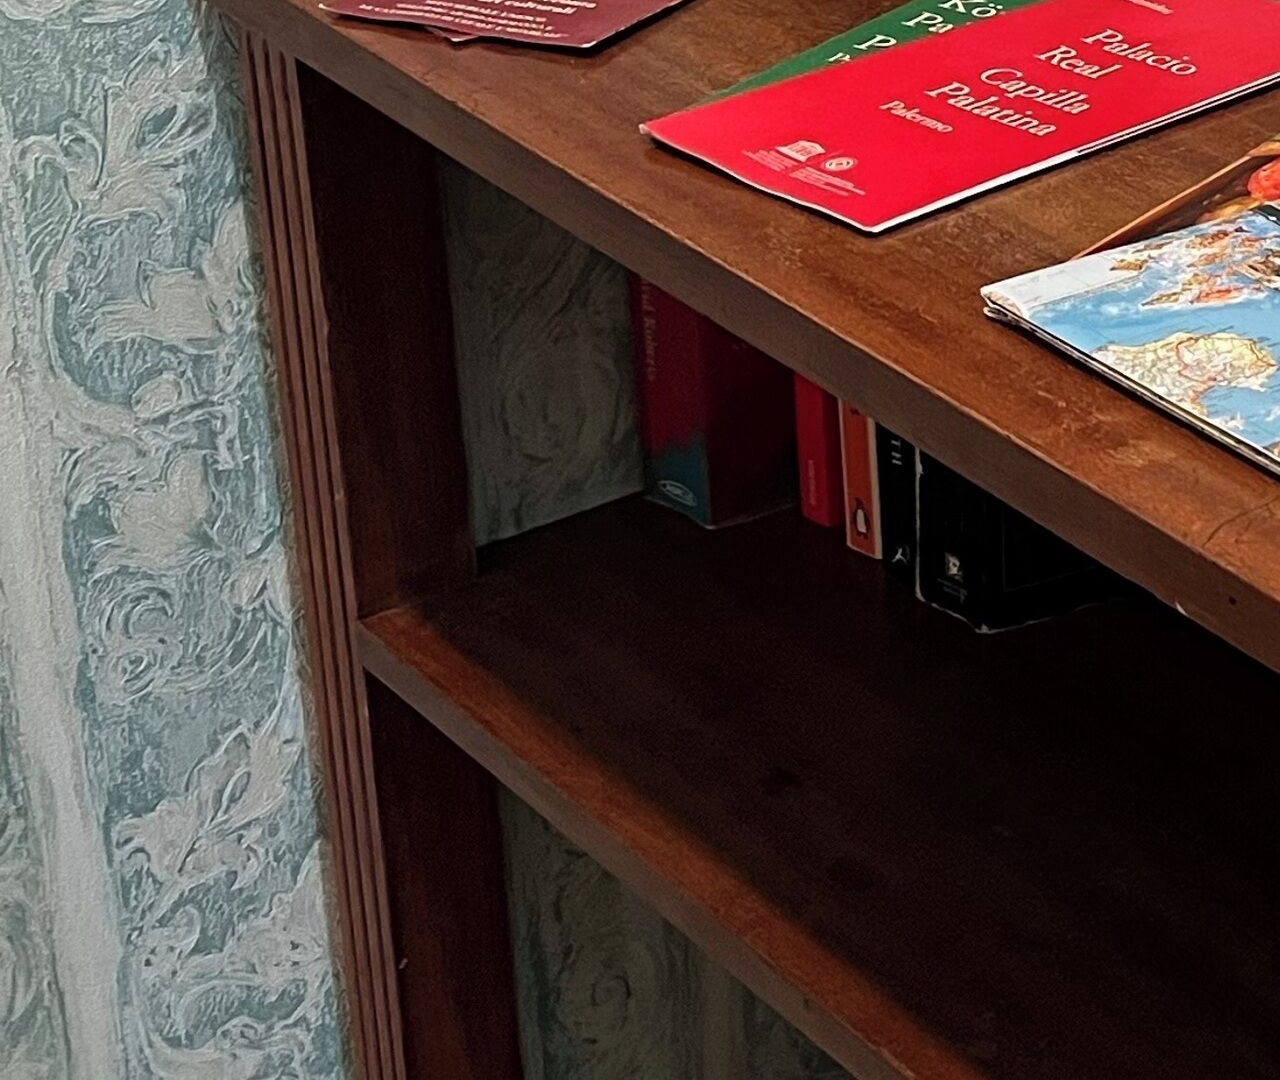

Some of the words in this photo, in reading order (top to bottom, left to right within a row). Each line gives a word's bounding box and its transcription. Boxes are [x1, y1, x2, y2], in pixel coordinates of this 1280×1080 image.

[901, 11, 955, 34] Pa
[853, 34, 898, 51] P
[1081, 28, 1197, 76] Palacio
[1034, 45, 1122, 79] Real
[980, 67, 1091, 114] Capilla
[880, 100, 953, 134] Palermo
[925, 81, 1057, 136] Palatina
